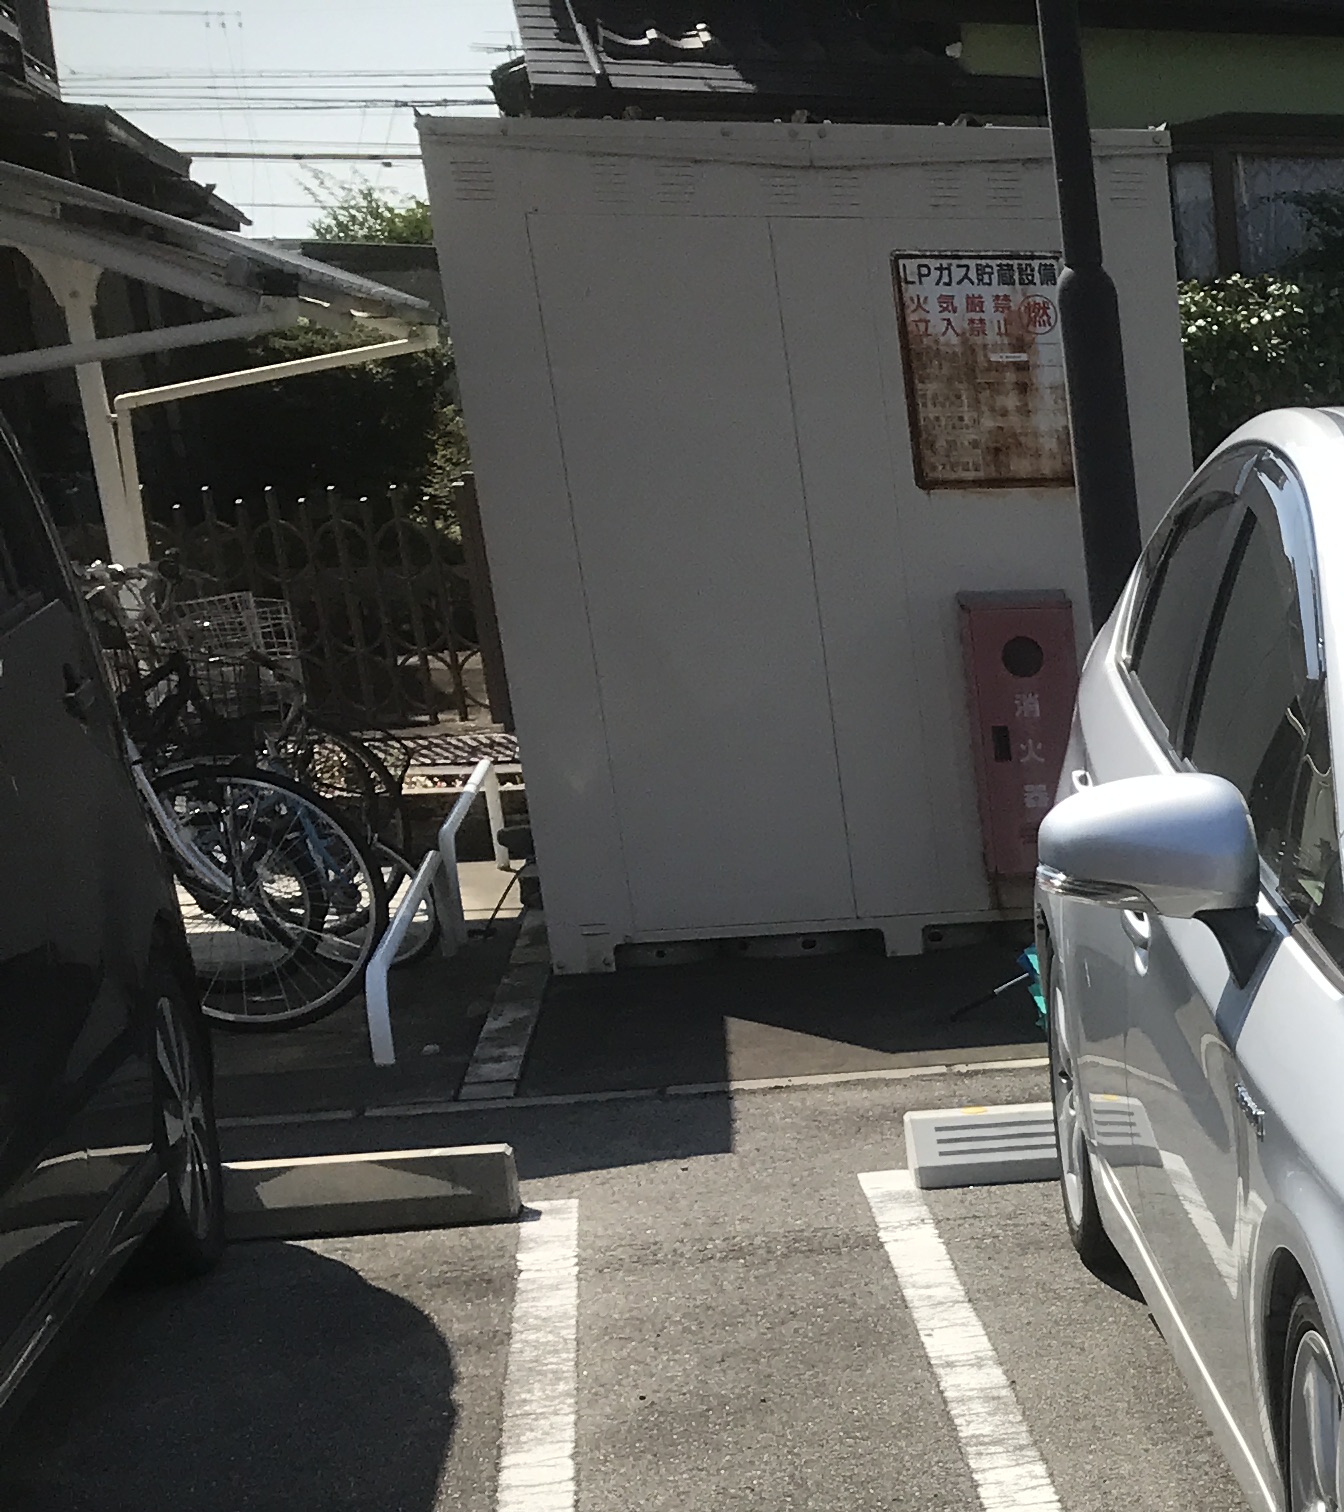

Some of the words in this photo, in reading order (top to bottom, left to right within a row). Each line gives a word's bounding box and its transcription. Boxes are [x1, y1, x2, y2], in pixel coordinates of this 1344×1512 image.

[902, 263, 1058, 286] LPガス貯蔵設備
[910, 294, 1012, 314] 火気厳禁
[911, 318, 1010, 337] 立入禁止
[1015, 692, 1049, 808] 消火器
